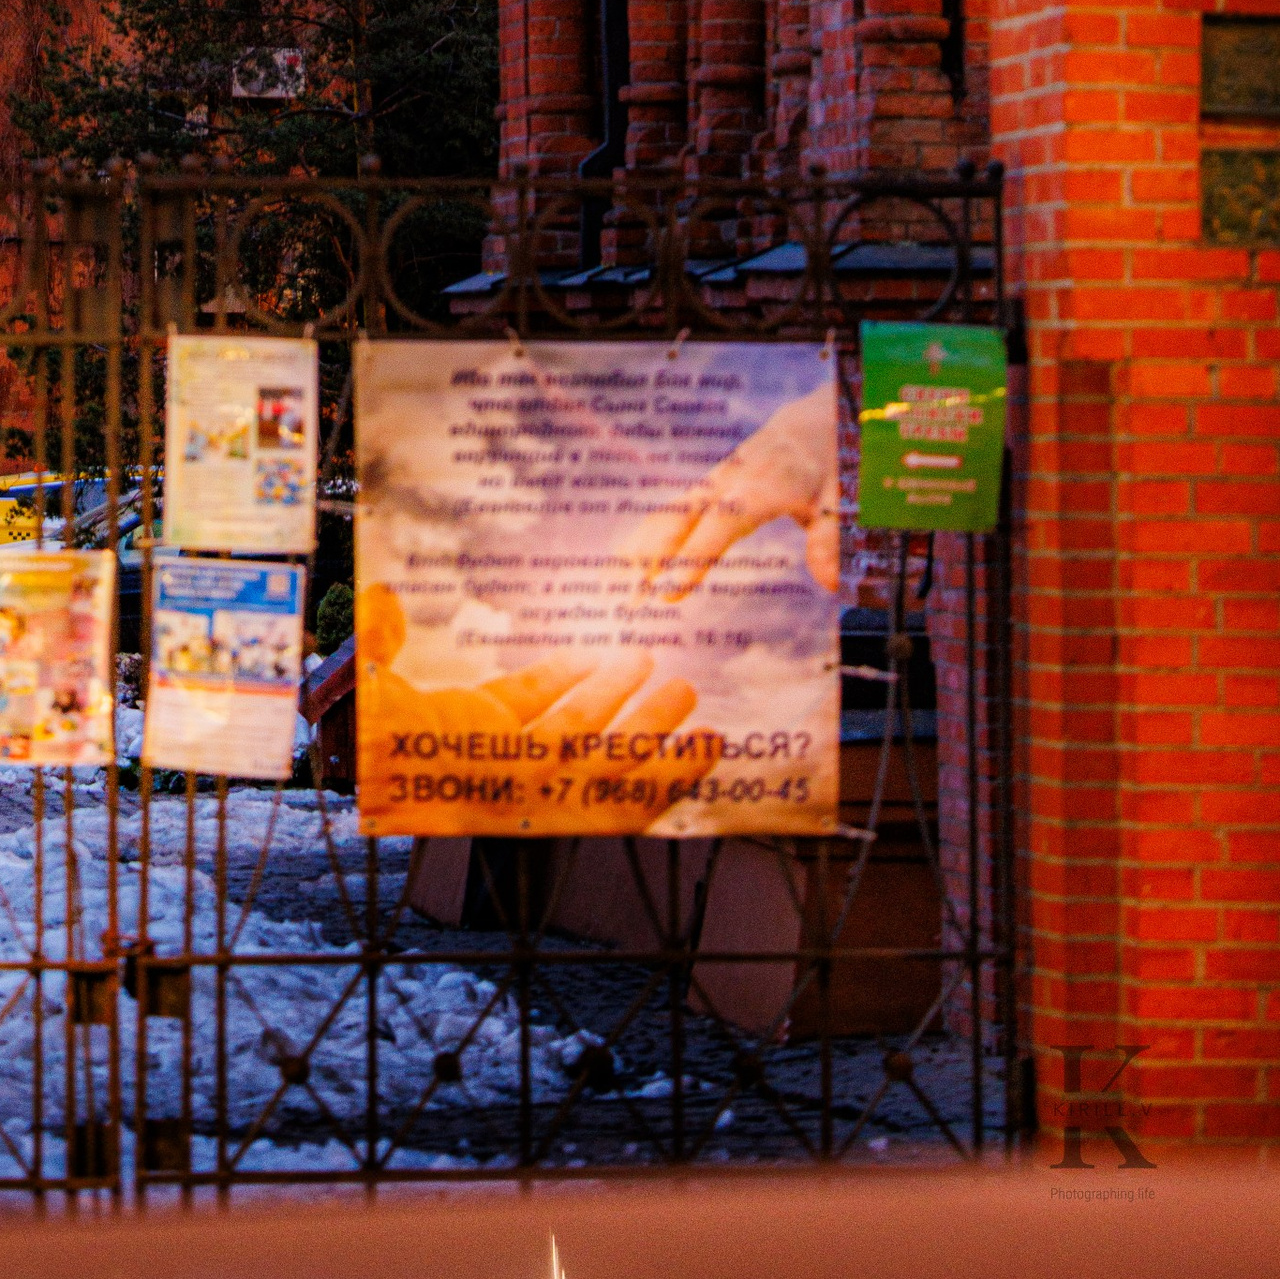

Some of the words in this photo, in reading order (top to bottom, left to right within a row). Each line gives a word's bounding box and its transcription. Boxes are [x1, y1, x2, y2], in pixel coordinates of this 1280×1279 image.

[389, 732, 547, 761] ХОЧЕШЬ
[559, 732, 811, 762] КРЕСТИТЬСЯ?
[389, 775, 524, 804] ЗВОНИ:
